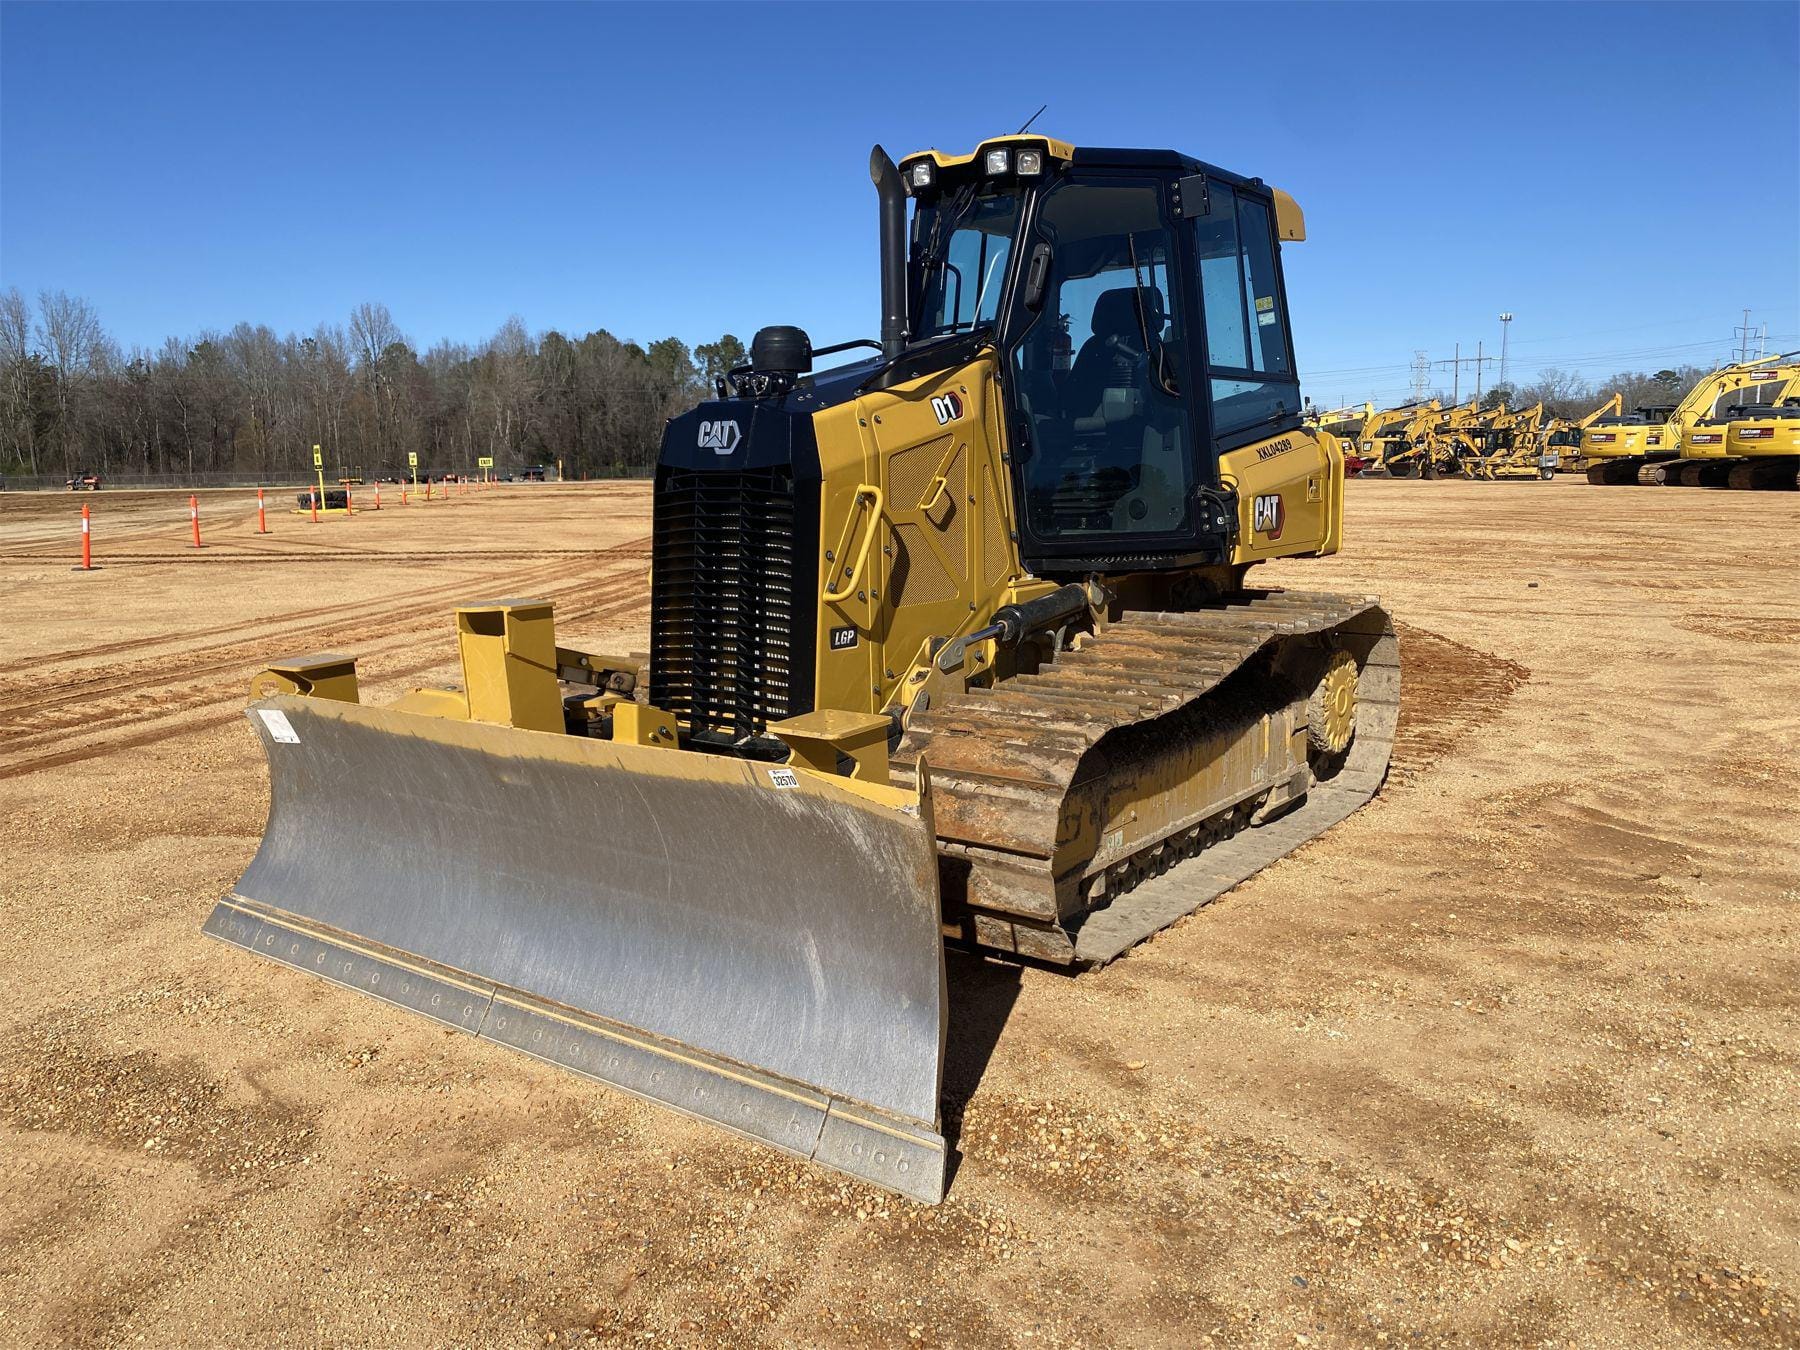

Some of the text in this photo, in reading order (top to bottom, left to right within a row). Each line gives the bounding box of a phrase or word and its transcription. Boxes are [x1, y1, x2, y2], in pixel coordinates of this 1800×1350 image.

[931, 394, 957, 424] D1
[698, 420, 731, 448] CAT
[1256, 439, 1292, 461] XKL04289
[1255, 495, 1279, 532] CAT
[835, 630, 855, 646] LGP
[773, 775, 797, 786] 32570
